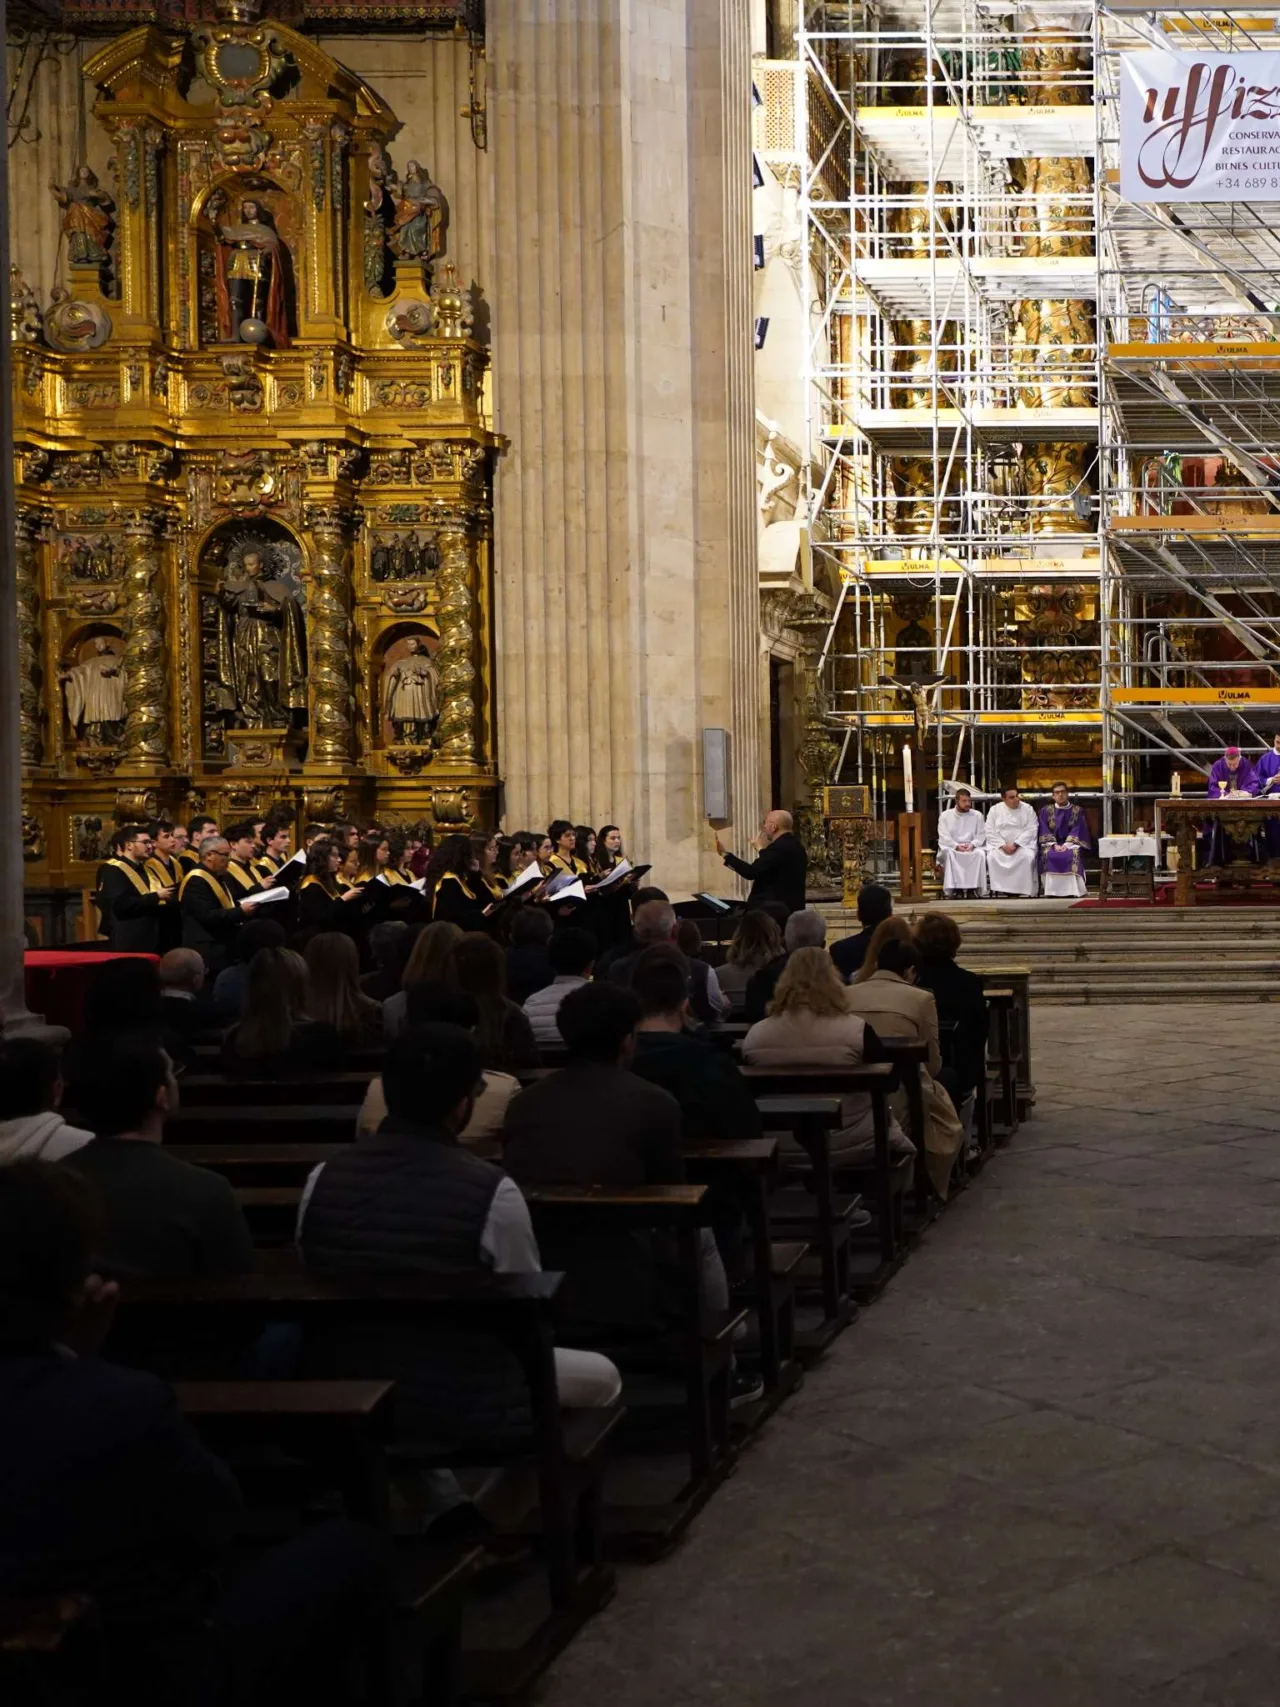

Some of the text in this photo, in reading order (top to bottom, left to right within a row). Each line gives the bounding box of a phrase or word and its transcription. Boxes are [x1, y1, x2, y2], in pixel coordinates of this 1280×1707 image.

[1215, 162, 1249, 171] BIENES
[1215, 177, 1240, 189] +34
[1244, 177, 1267, 189] 689
